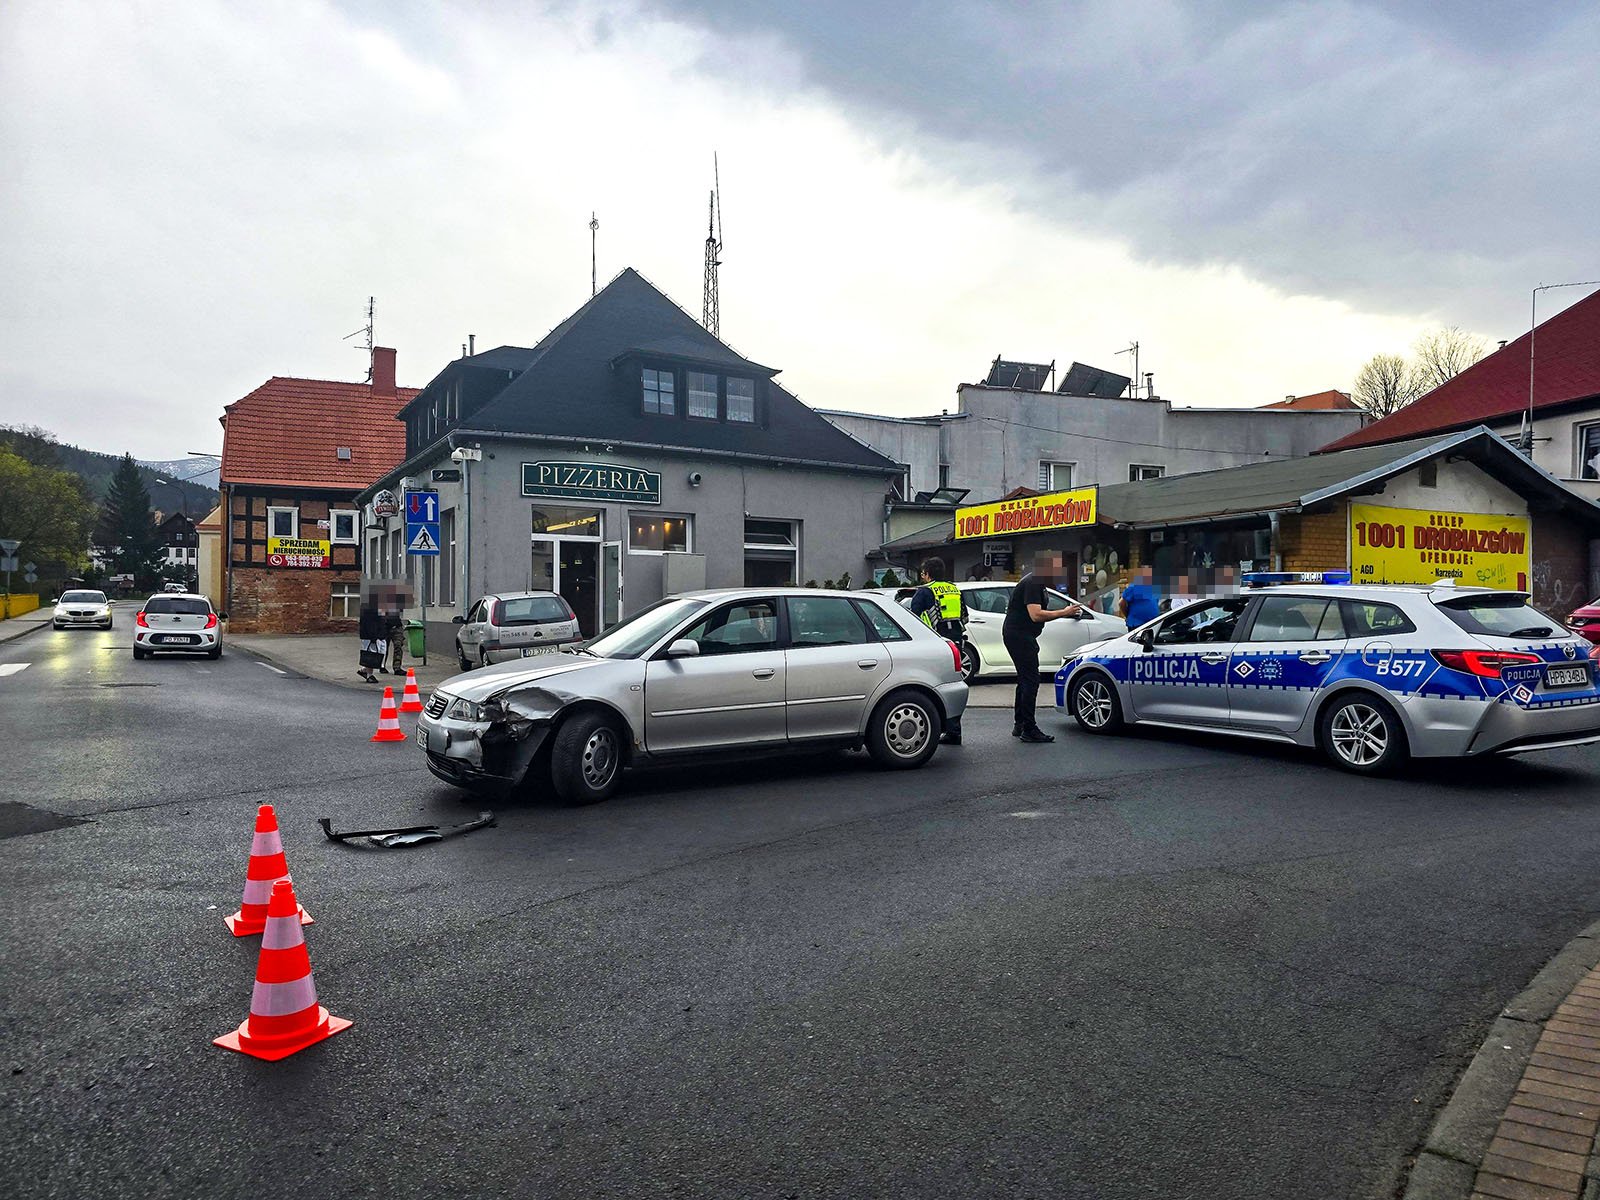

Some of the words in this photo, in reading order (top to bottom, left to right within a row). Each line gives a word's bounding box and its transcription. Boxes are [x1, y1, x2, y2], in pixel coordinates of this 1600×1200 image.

[538, 465, 649, 491] PIZZERIA
[525, 488, 658, 500] COLOSSEUM
[1000, 499, 1039, 511] SKLEP
[958, 514, 989, 536] 1001
[993, 498, 1092, 532] DROBIAZGÓW
[1429, 514, 1464, 527] SKLEP
[279, 539, 320, 548] SPRZEDAM
[1355, 522, 1405, 548] 1001
[1413, 525, 1525, 555] DROBIAZGÓW
[1420, 551, 1474, 565] OFERUJE:
[1360, 565, 1374, 575] AGD
[1434, 567, 1464, 578] Narzędzia
[1134, 660, 1200, 679] POLICJA
[1376, 659, 1426, 677] B577
[1507, 668, 1541, 681] POLICJA
[1549, 671, 1566, 684] HPB
